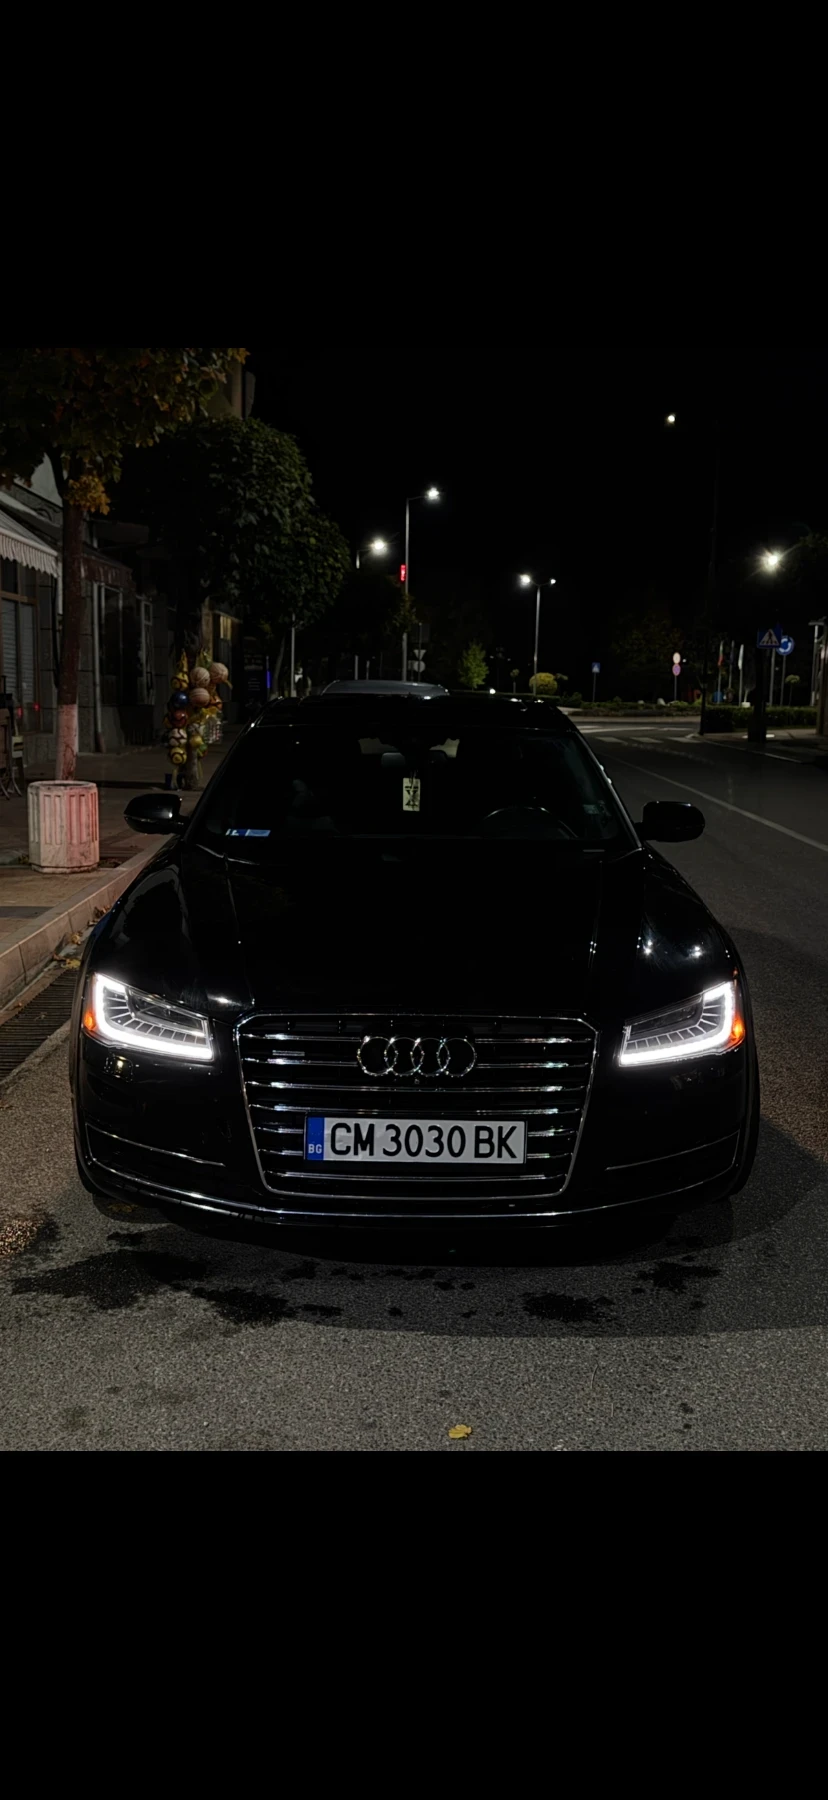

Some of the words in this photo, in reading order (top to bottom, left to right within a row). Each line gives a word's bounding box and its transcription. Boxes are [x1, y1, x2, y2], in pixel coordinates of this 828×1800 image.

[308, 1143, 323, 1154] BG
[330, 1122, 375, 1156] CM
[382, 1124, 466, 1158] 3030
[474, 1126, 517, 1159] BK
